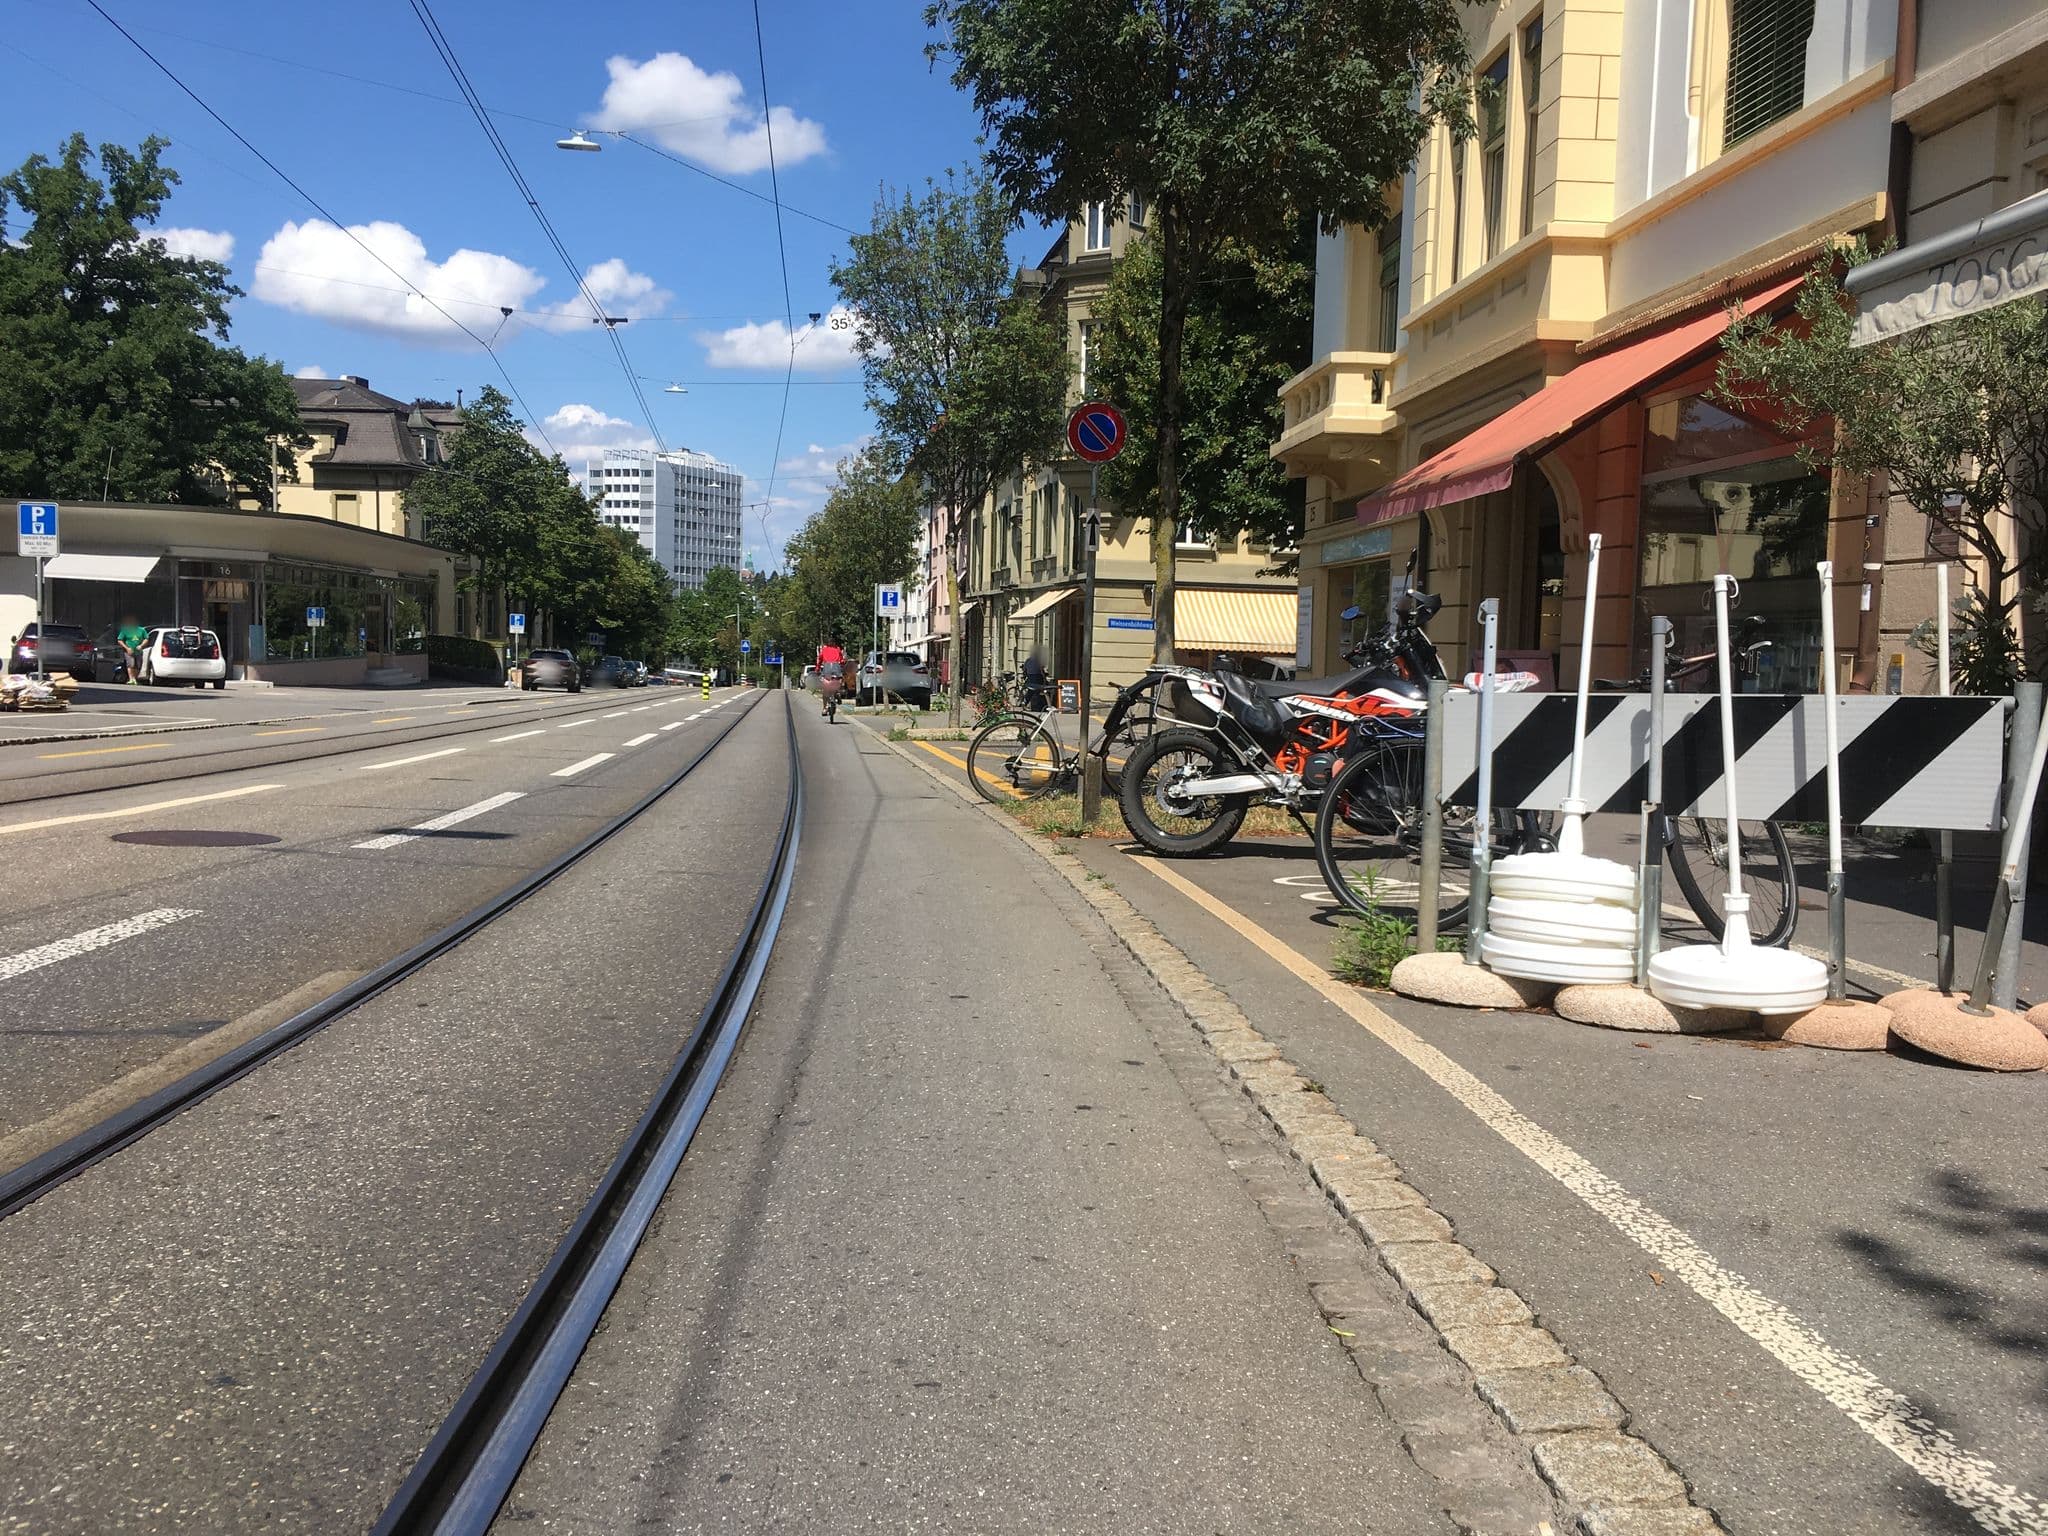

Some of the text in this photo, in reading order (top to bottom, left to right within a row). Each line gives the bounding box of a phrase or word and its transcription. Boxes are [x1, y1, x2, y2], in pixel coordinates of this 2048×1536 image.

[831, 318, 848, 331] 35
[31, 506, 45, 522] P
[219, 566, 231, 575] 16
